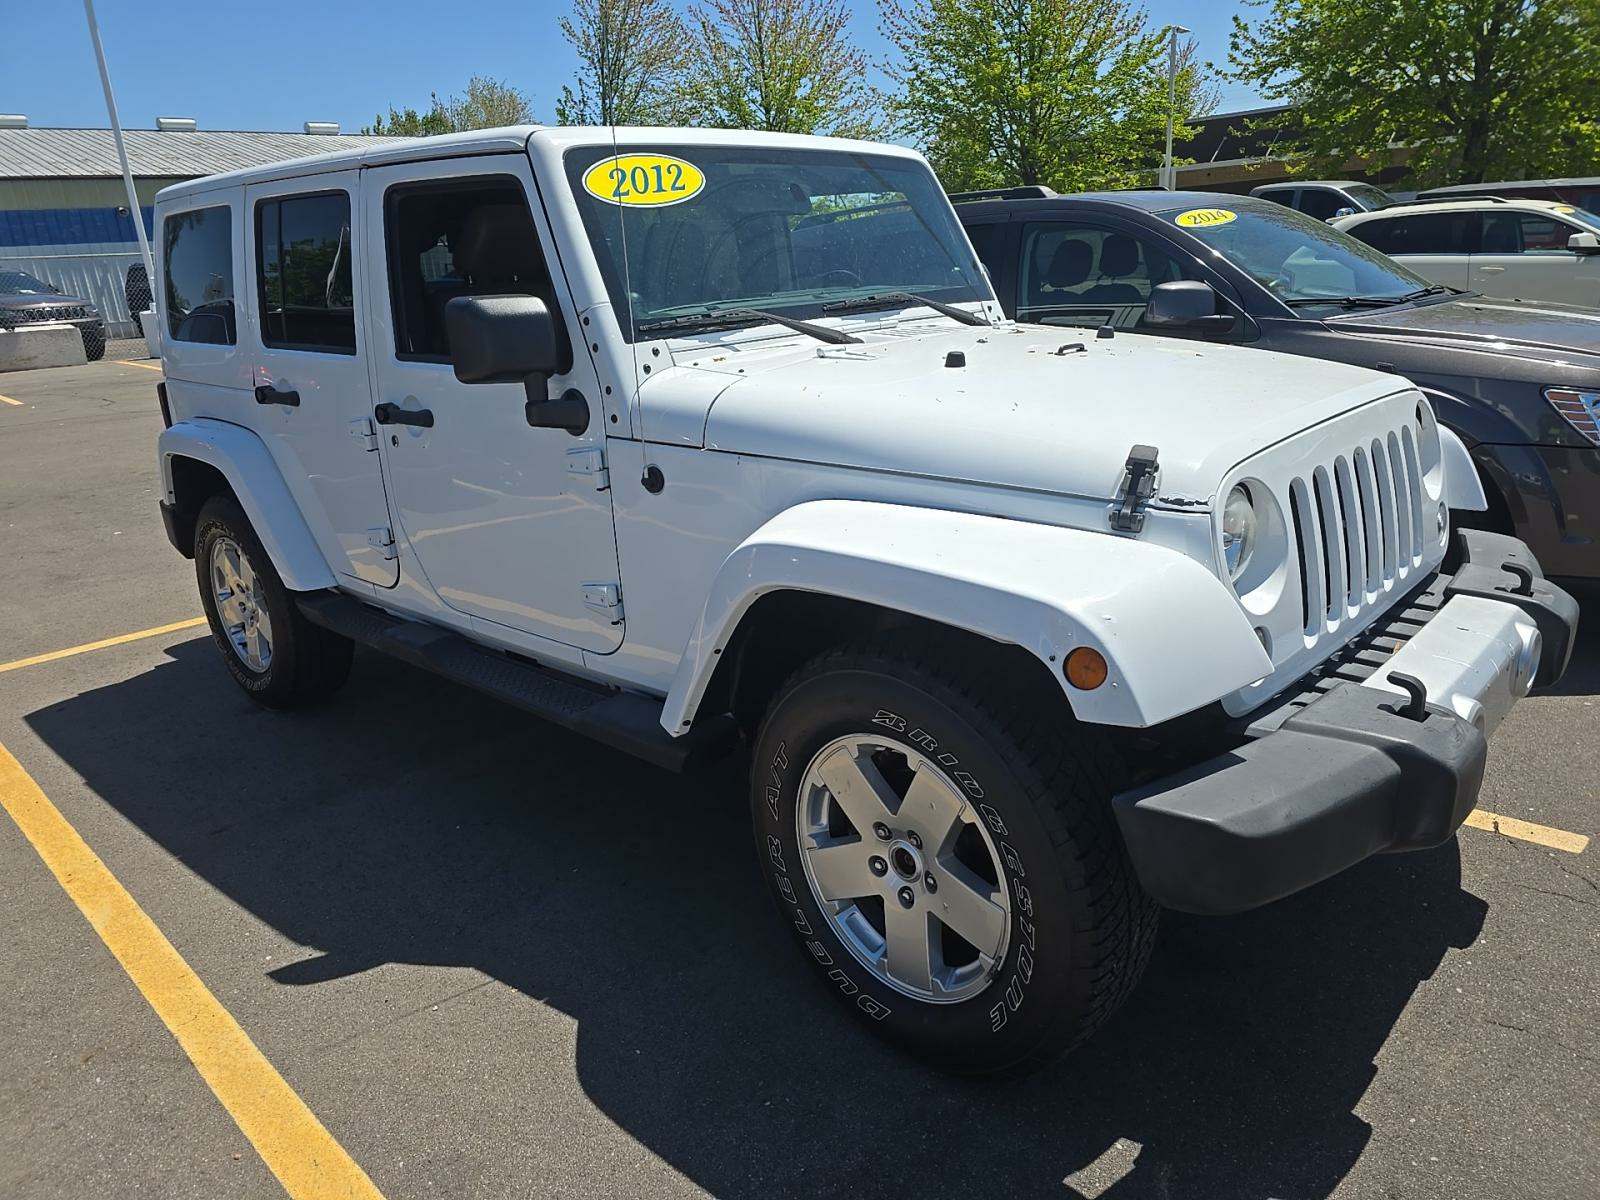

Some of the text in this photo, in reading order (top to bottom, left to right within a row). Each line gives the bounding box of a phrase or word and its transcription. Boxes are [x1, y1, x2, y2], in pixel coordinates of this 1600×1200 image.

[608, 164, 685, 197] 2012
[1187, 210, 1227, 224] 2014
[766, 742, 891, 1020] DUELER A/T
[872, 710, 1035, 1032] BRIDGESTONE
